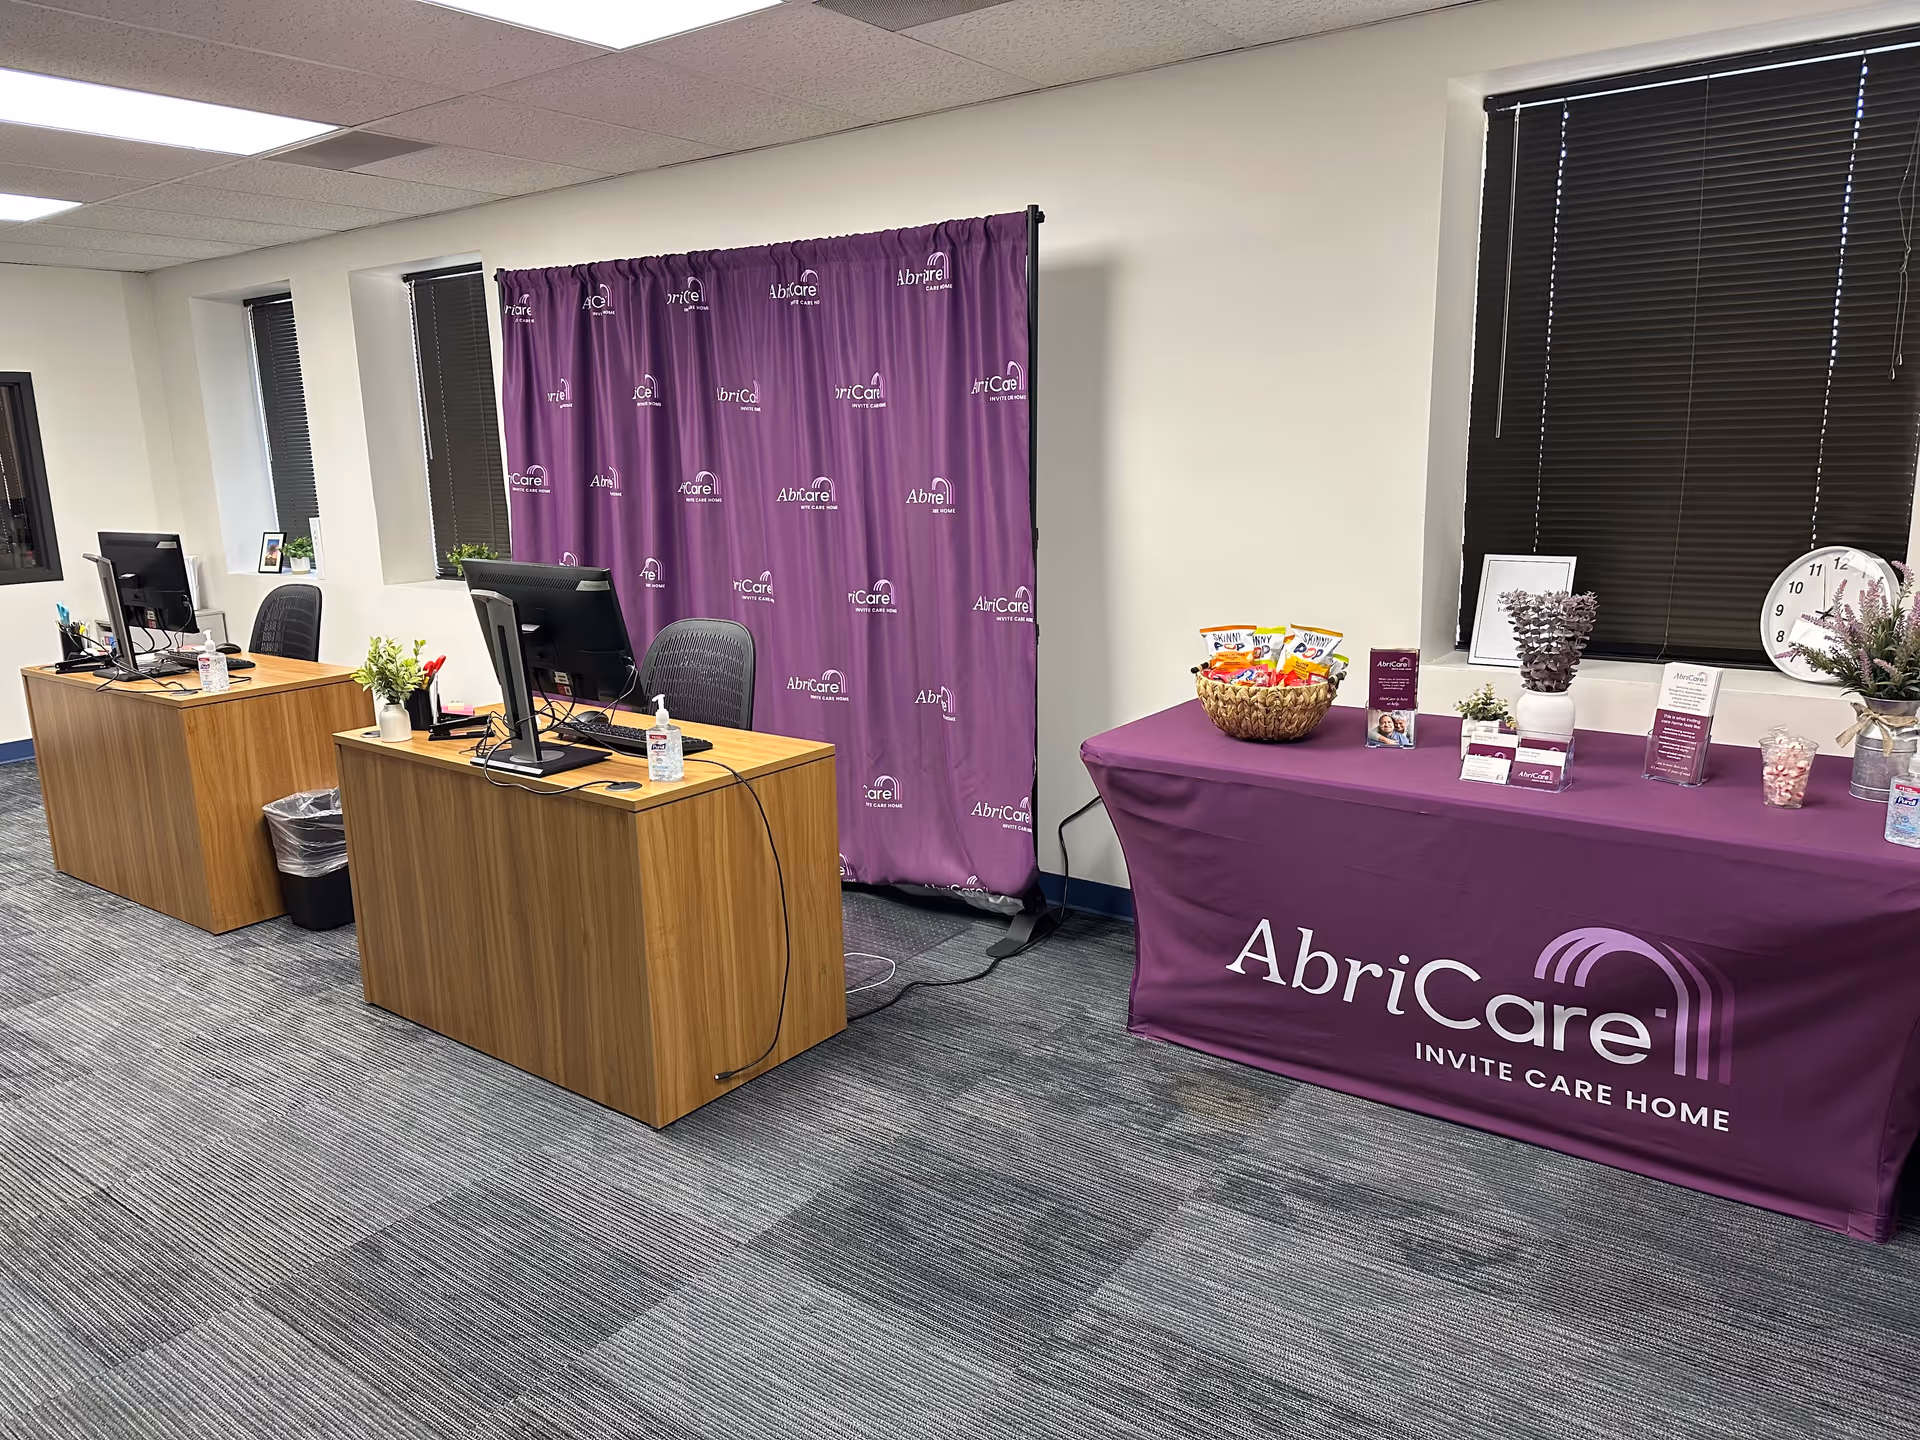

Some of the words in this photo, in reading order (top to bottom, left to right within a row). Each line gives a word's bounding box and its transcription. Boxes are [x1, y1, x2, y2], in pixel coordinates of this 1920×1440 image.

[1809, 563, 1823, 576] 11
[1833, 557, 1850, 570] 12
[1789, 581, 1804, 594] 10
[973, 596, 1029, 613] AbriCare
[1775, 604, 1784, 617] 9
[1302, 633, 1332, 648] SKINNY
[1776, 630, 1785, 642] 8
[1214, 642, 1245, 651] POP
[1293, 642, 1324, 660] POP
[1376, 660, 1408, 668] AbriCare
[1673, 672, 1704, 683] AbriCare
[786, 677, 839, 693] AbriCare
[1518, 771, 1549, 781] AbriCare
[1897, 796, 1918, 806] Purell
[971, 801, 1030, 823] AbriCare
[1226, 917, 1651, 1065] AbriCare
[1415, 1041, 1513, 1082] INVITE
[1524, 1069, 1613, 1105] CARE
[1625, 1090, 1730, 1132] HOME
